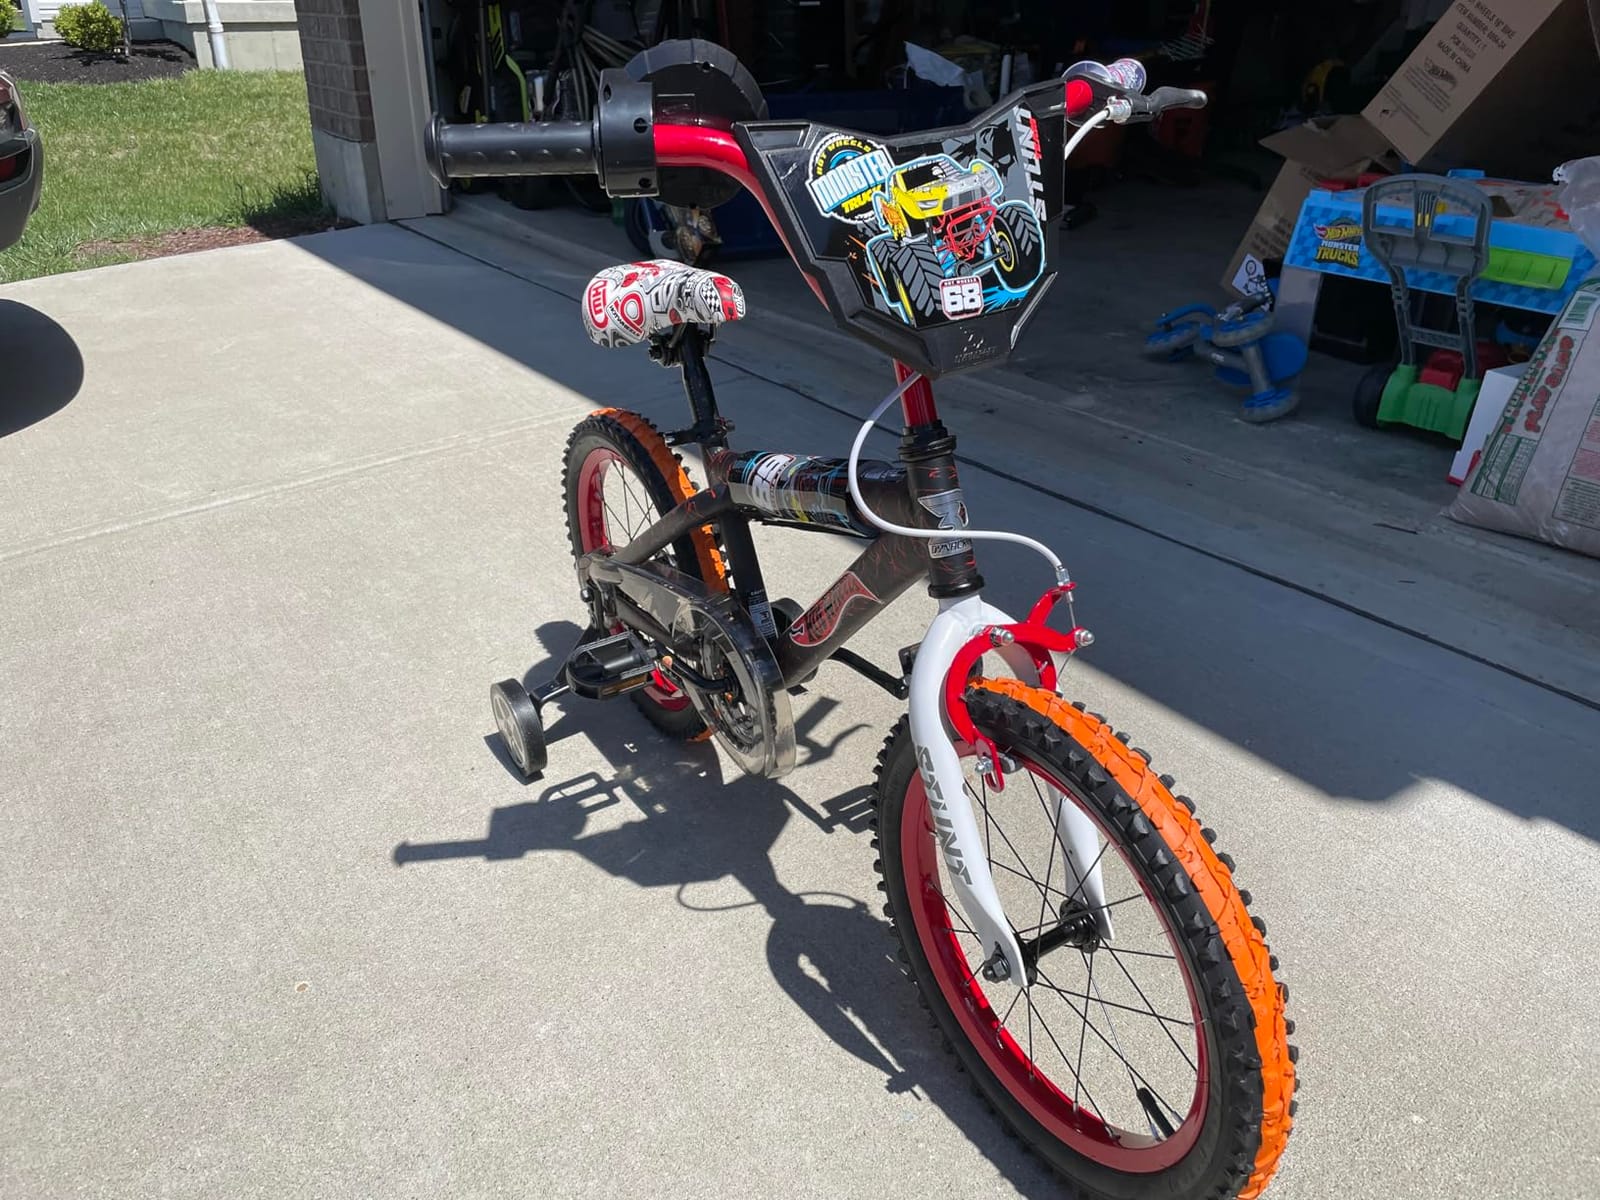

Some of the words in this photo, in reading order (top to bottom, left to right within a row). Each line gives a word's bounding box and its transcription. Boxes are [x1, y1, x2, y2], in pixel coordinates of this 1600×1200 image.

[817, 152, 829, 176] HOT
[828, 138, 872, 152] WHEELS
[1014, 105, 1047, 221] STUNT
[811, 150, 894, 209] MONSTER
[1316, 248, 1360, 267] TRUCKS
[1321, 239, 1359, 252] MONSTER
[943, 283, 982, 316] 68
[917, 745, 972, 885] STUNT
